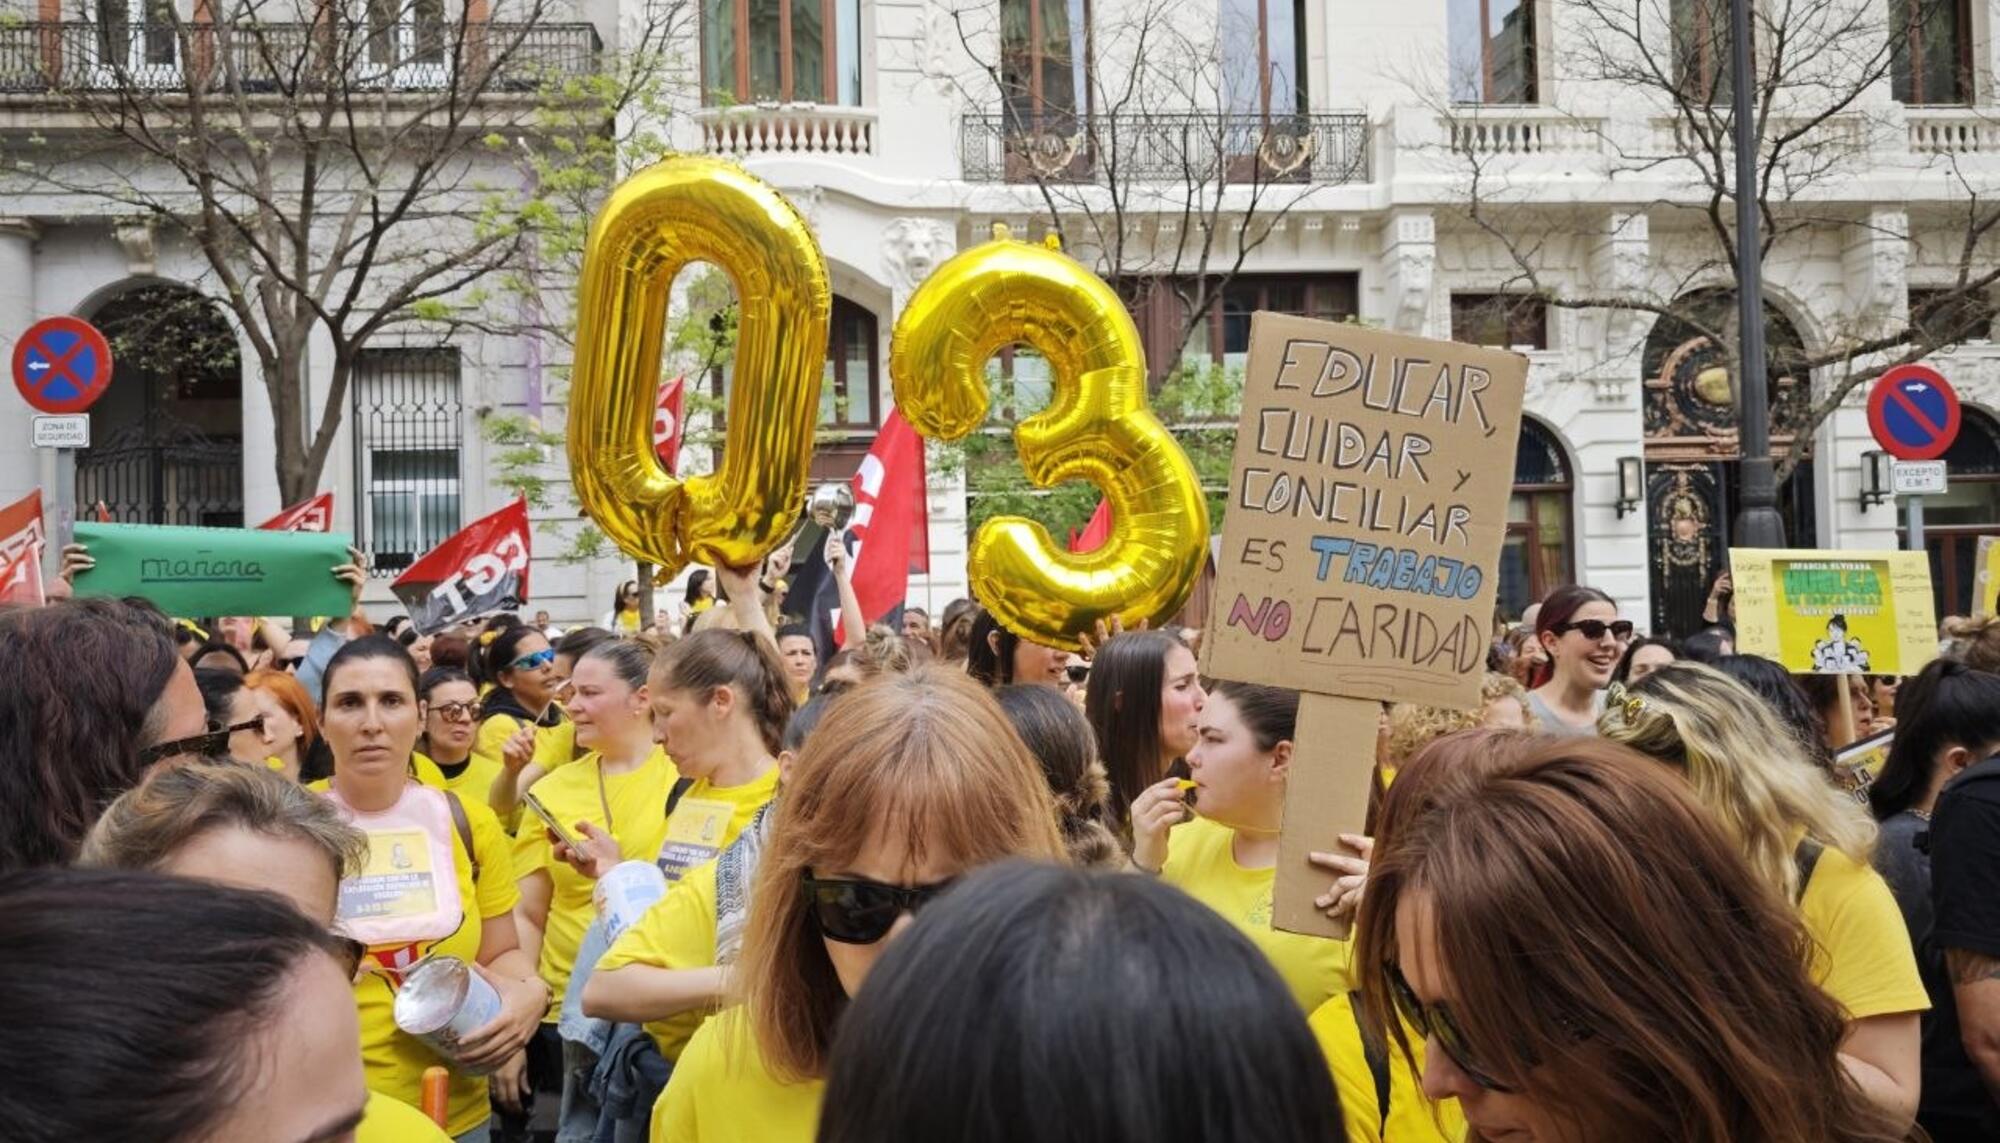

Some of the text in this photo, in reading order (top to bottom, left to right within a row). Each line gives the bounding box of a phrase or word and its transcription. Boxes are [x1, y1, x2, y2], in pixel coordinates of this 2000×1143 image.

[1274, 339, 1496, 437] EDUCAR,
[890, 226, 1211, 650] 3
[1257, 407, 1432, 484] CUIDAR
[1896, 466, 1941, 477] EXCEPTO
[1240, 468, 1472, 546] CONCILIAR
[141, 550, 265, 578] mañana
[1241, 535, 1483, 600] ES TRABAJO
[1227, 593, 1482, 675] NO CARIDAD
